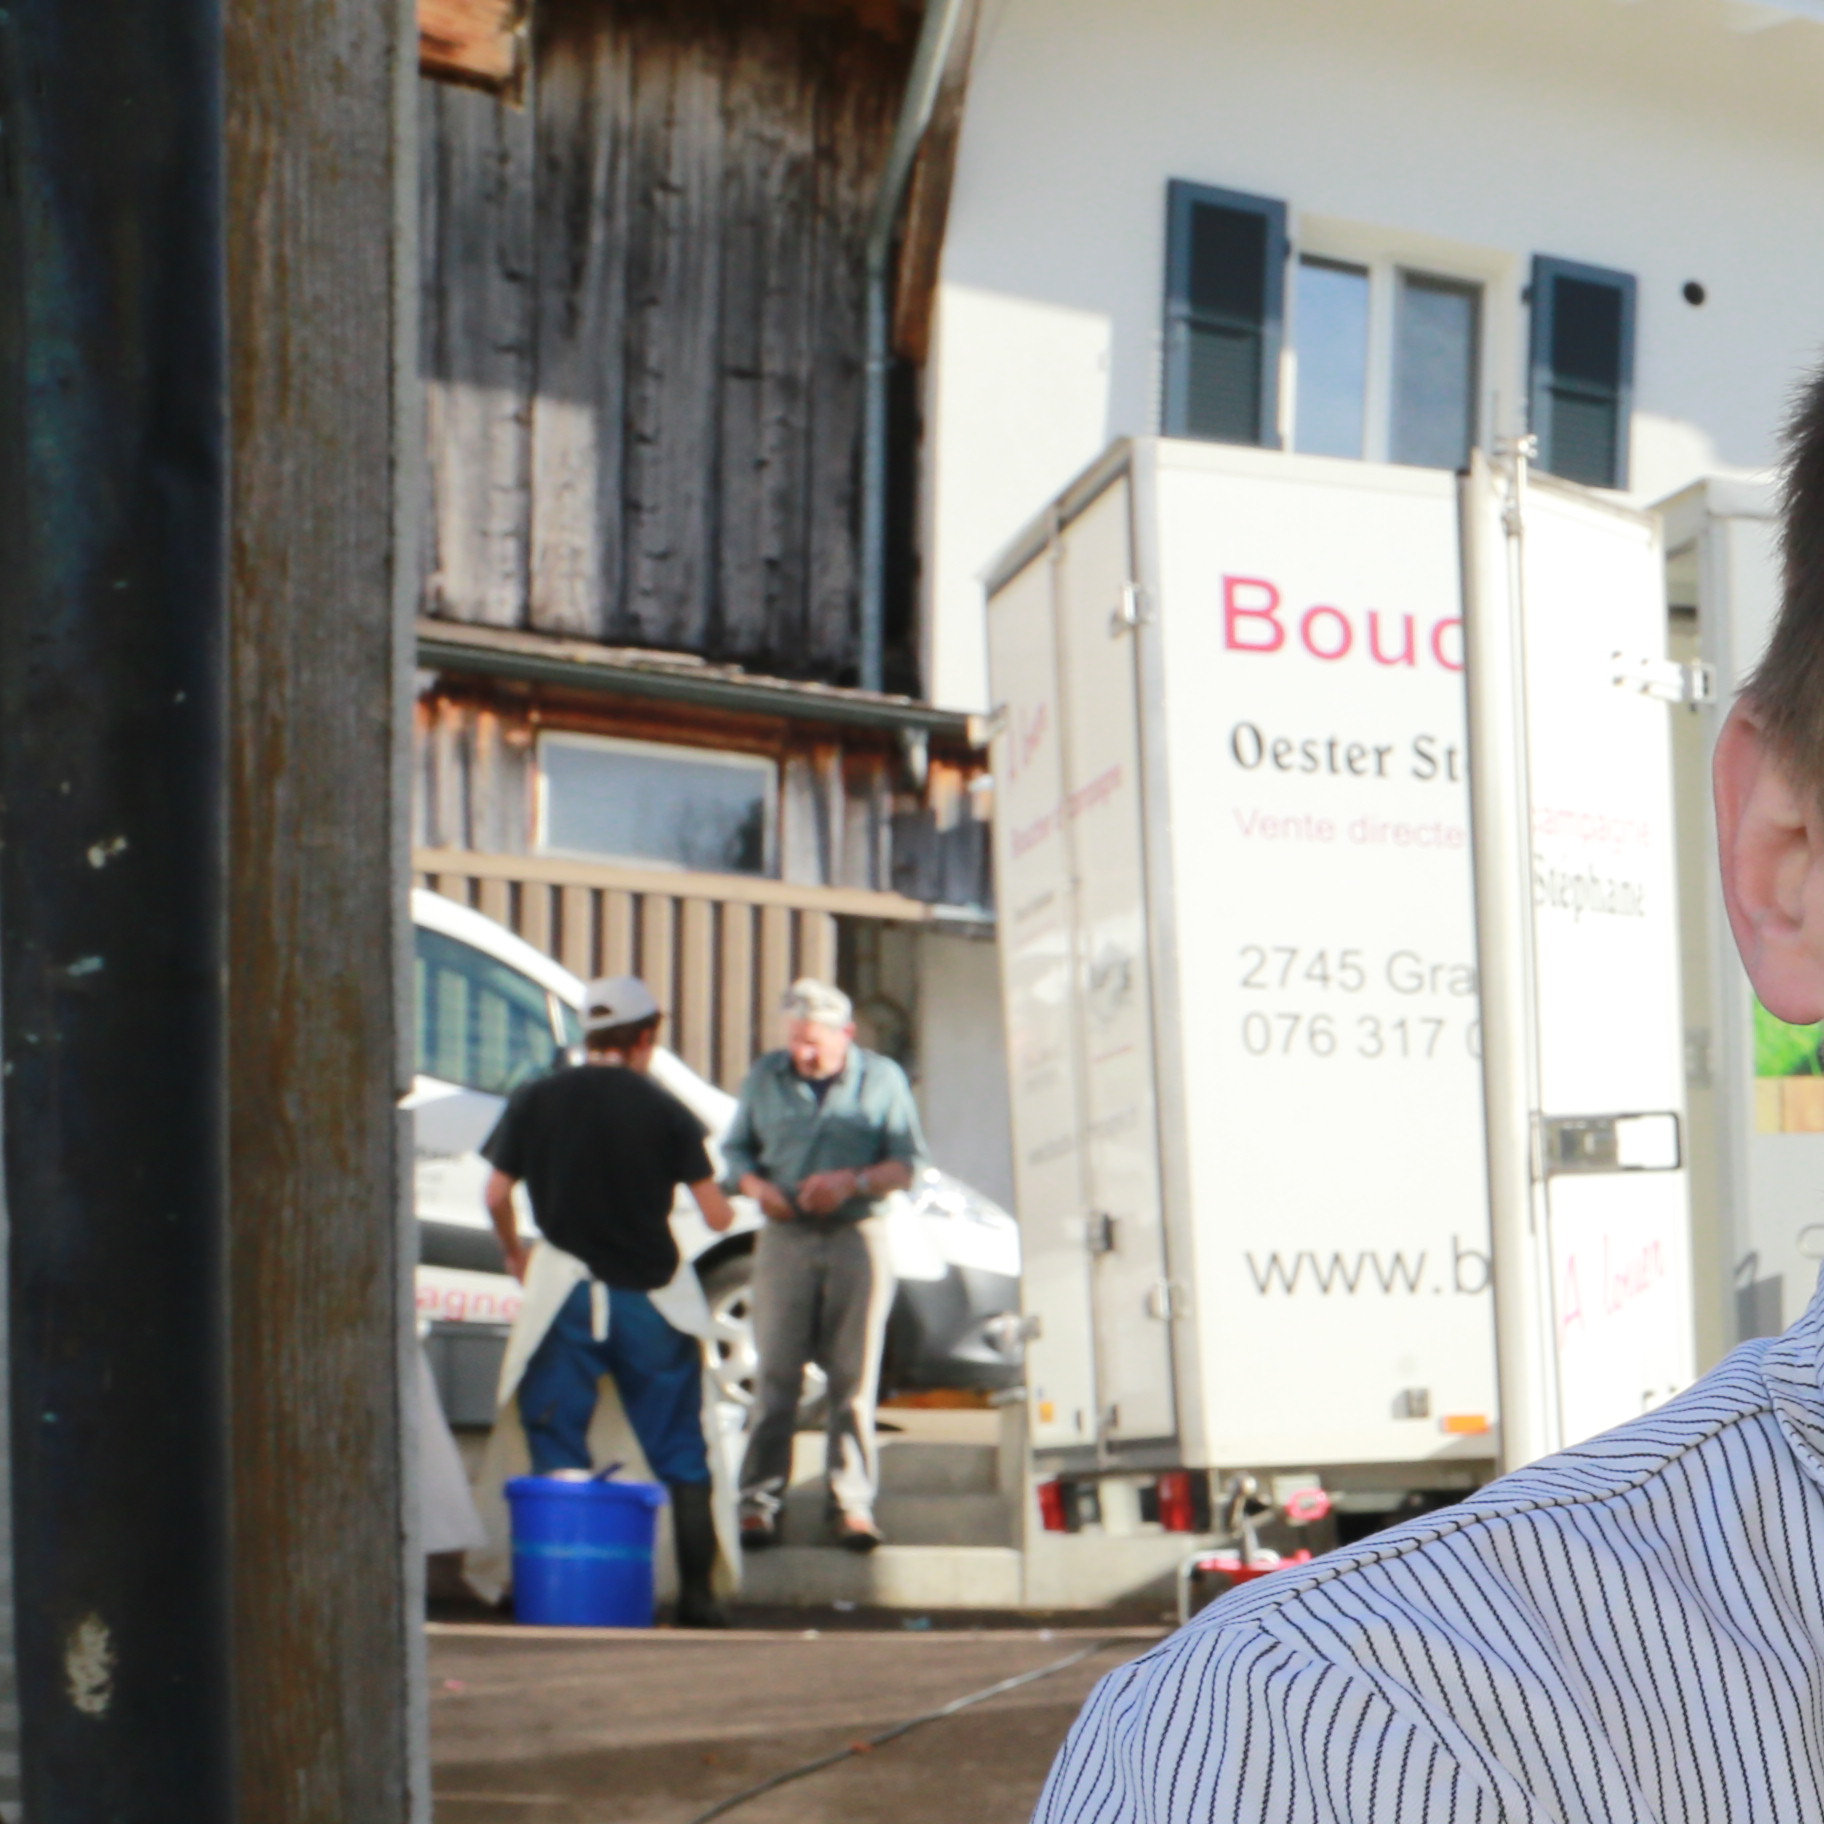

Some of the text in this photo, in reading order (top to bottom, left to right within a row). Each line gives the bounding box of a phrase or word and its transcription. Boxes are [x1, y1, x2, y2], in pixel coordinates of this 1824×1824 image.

[1231, 721, 1394, 778] Oester
[1233, 804, 1467, 848] Vente directe
[1239, 944, 1367, 994] 2745
[1242, 1010, 1338, 1059] 076
[1356, 1014, 1446, 1060] 317
